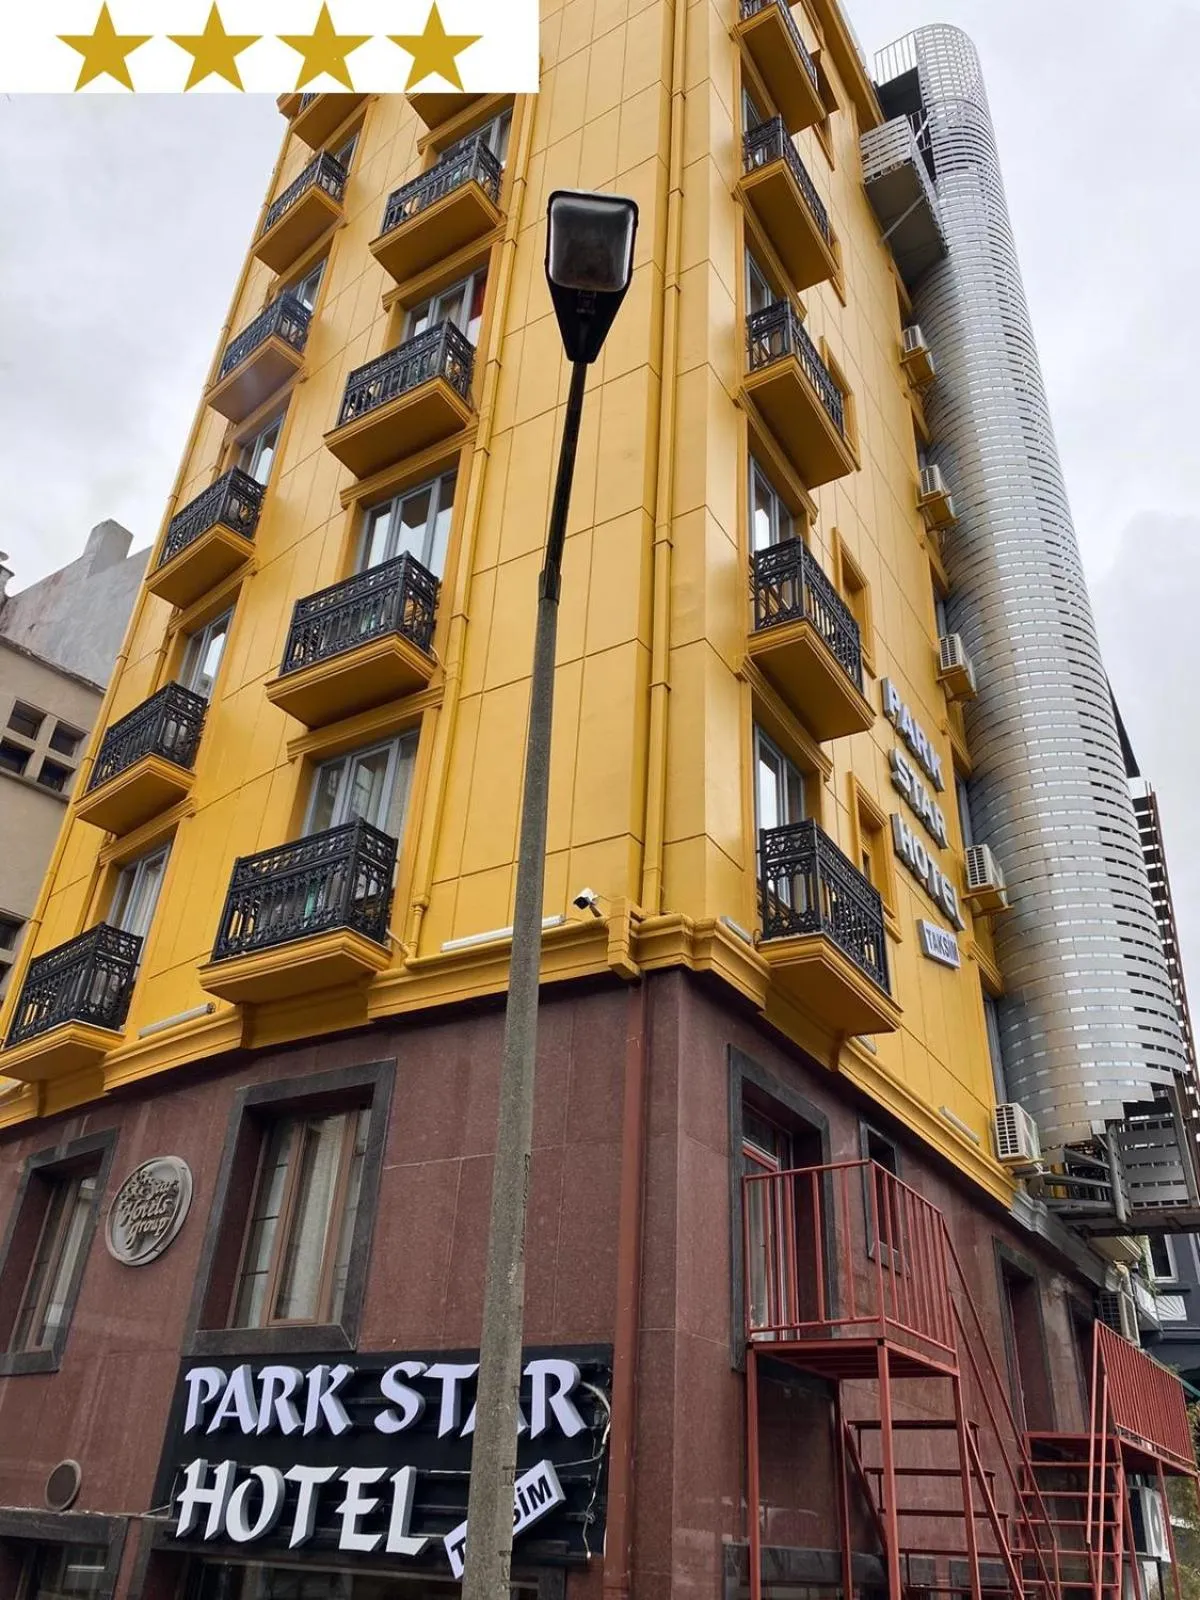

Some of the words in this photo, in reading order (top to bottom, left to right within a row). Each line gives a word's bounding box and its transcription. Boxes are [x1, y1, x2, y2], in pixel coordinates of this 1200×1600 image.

[882, 677, 945, 793] PARK
[889, 748, 949, 850] STAR
[890, 812, 966, 932] HOTEL
[125, 1217, 171, 1251] group
[183, 1364, 354, 1437] PARK
[374, 1359, 588, 1440] STR
[175, 1458, 430, 1556] HOTEL
